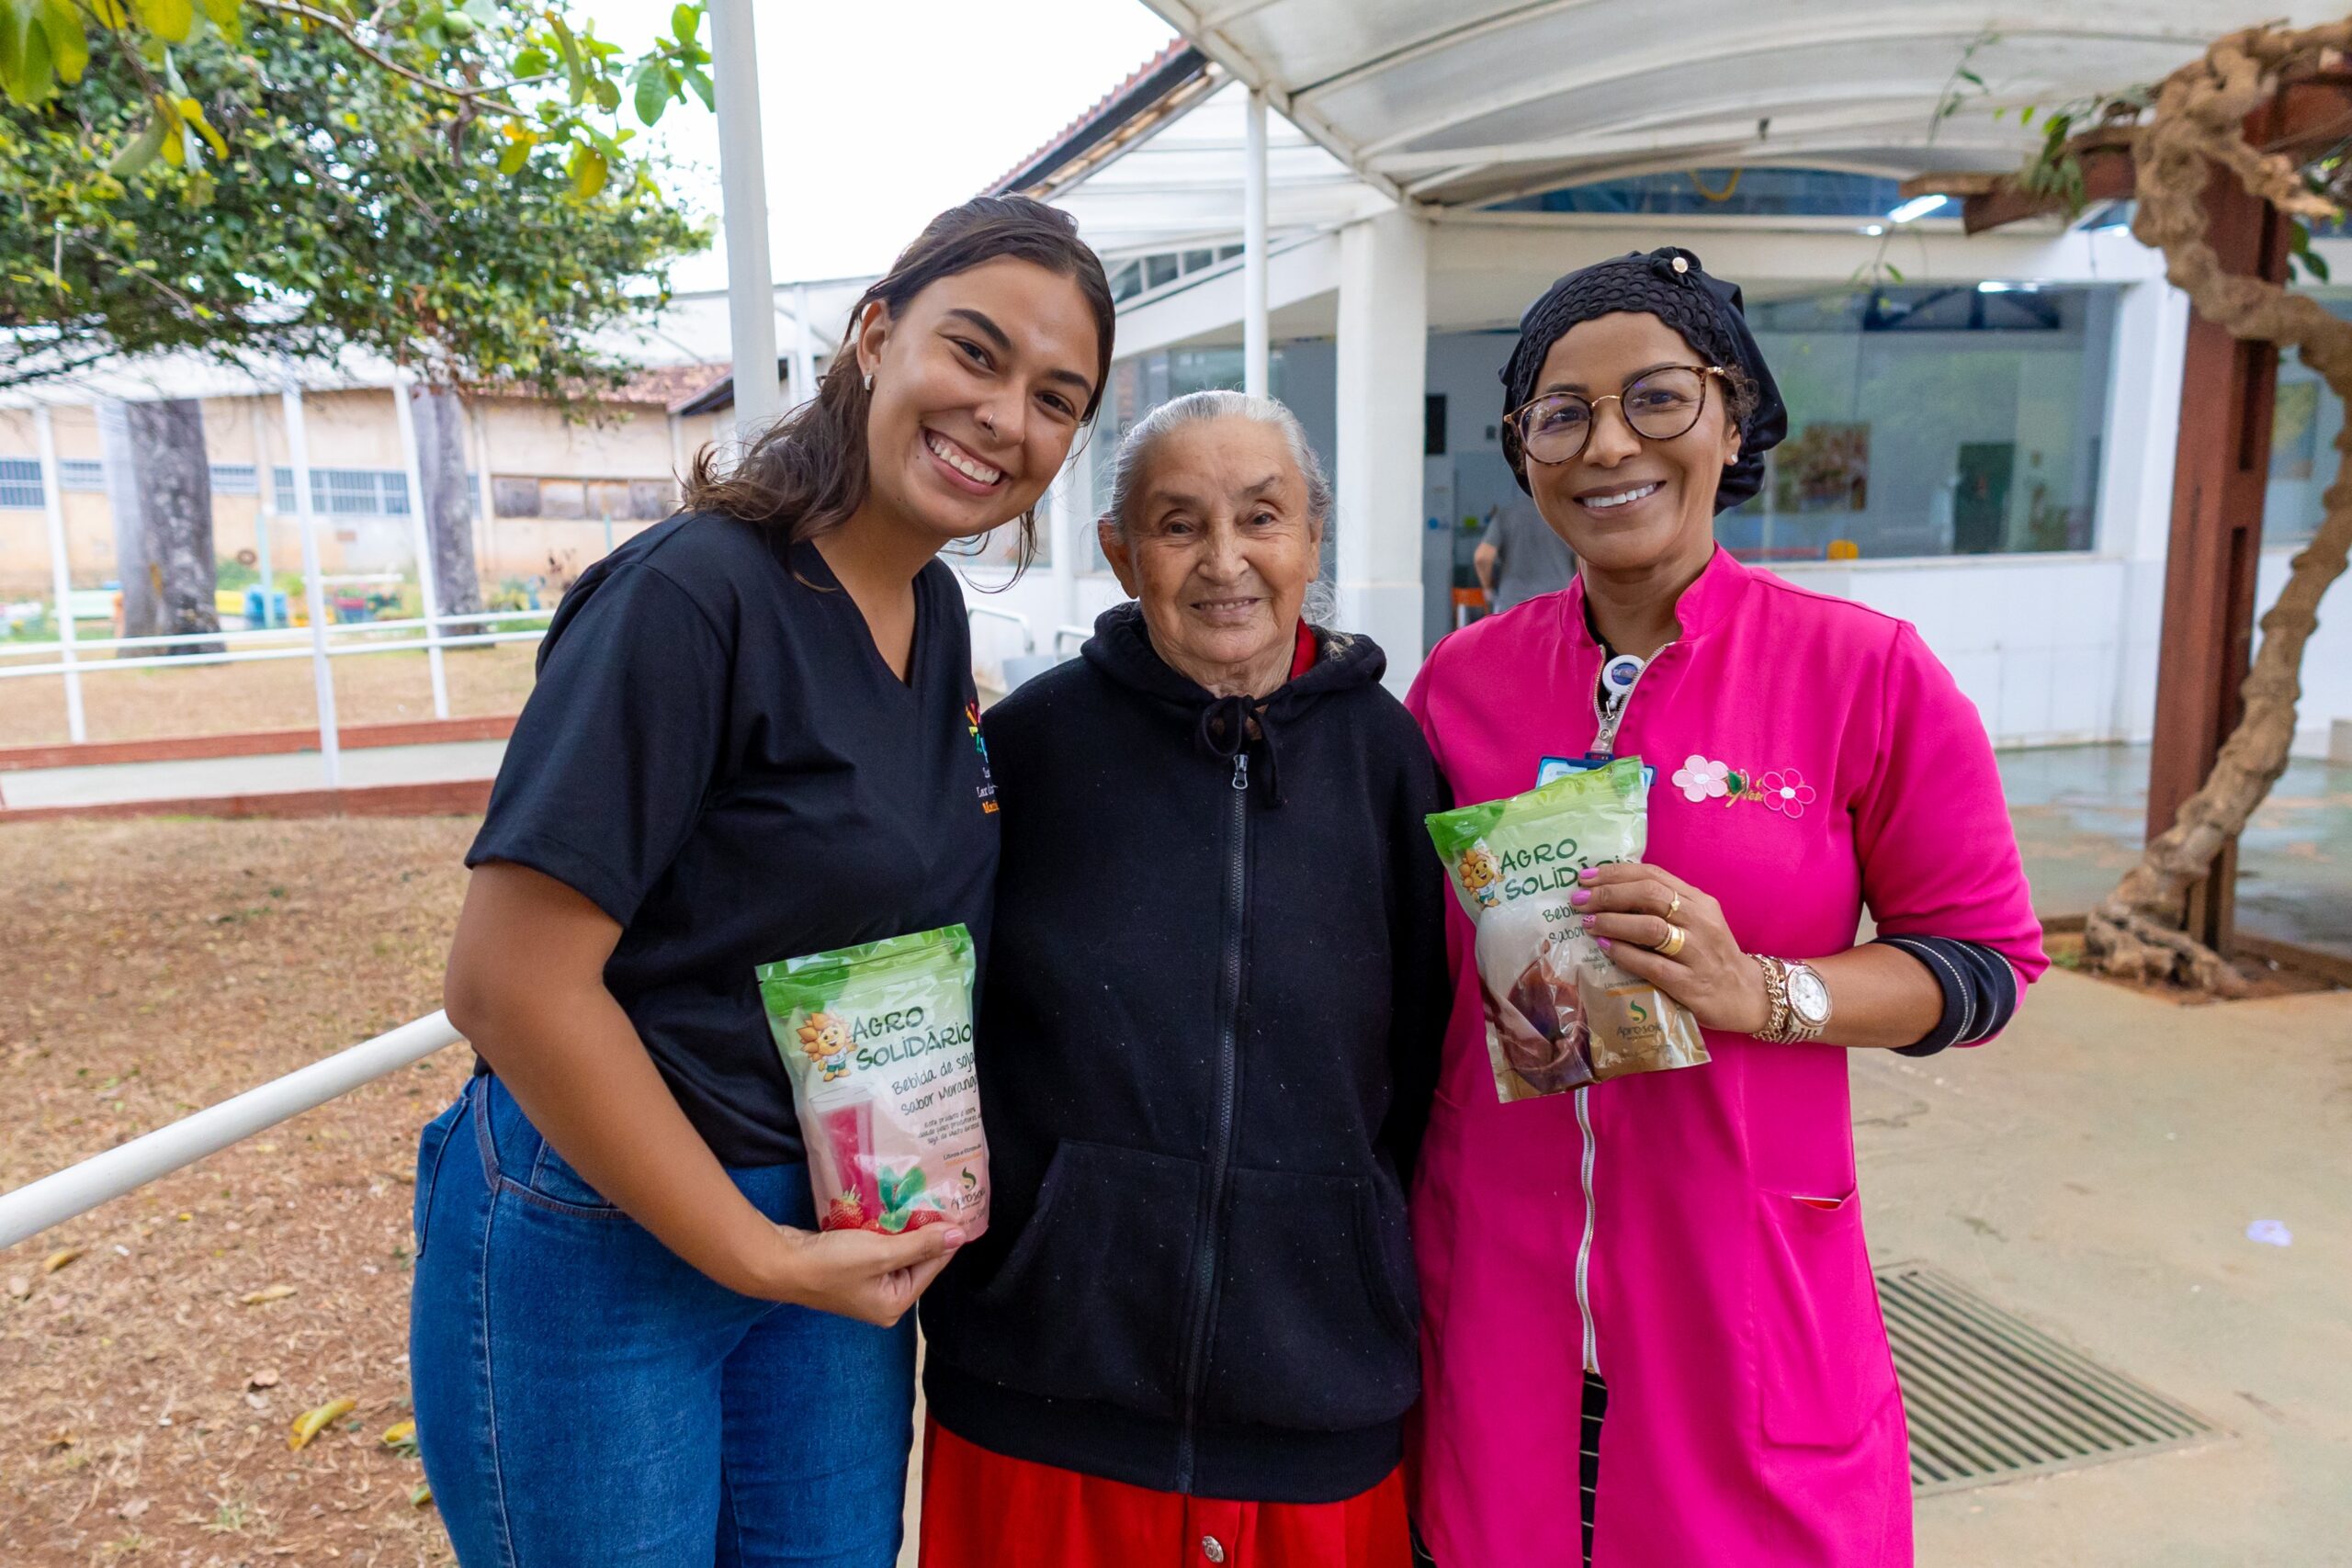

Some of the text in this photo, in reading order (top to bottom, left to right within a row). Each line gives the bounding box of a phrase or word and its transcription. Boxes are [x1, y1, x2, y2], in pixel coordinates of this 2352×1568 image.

[1499, 838, 1578, 874] AGRO
[852, 1006, 925, 1043] AGRO
[891, 1068, 937, 1096] Bebida
[940, 1061, 954, 1077] de
[938, 1074, 978, 1101] Morang
